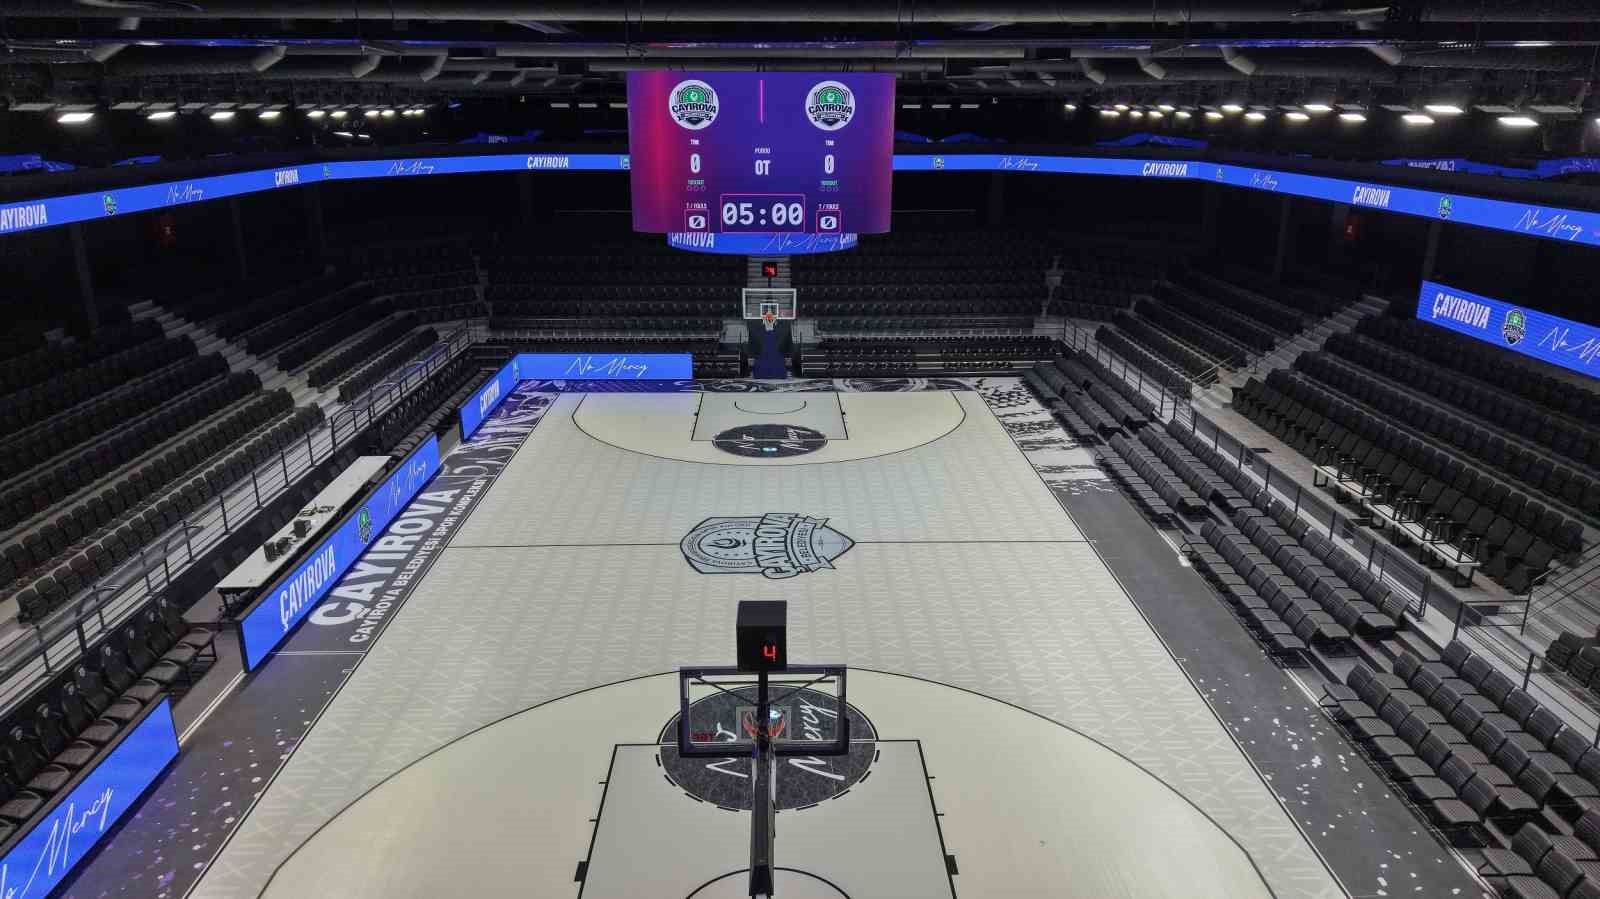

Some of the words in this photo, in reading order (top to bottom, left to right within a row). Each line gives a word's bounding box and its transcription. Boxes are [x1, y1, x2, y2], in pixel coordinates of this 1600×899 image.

[691, 154, 700, 173] 0
[755, 160, 771, 175] OT
[825, 154, 834, 174] 0
[722, 203, 803, 225] 05:00
[1432, 292, 1491, 329] ÇAYIROVA
[309, 488, 461, 626] ÇAYIROVA
[279, 543, 336, 632] ÇAYIROVA
